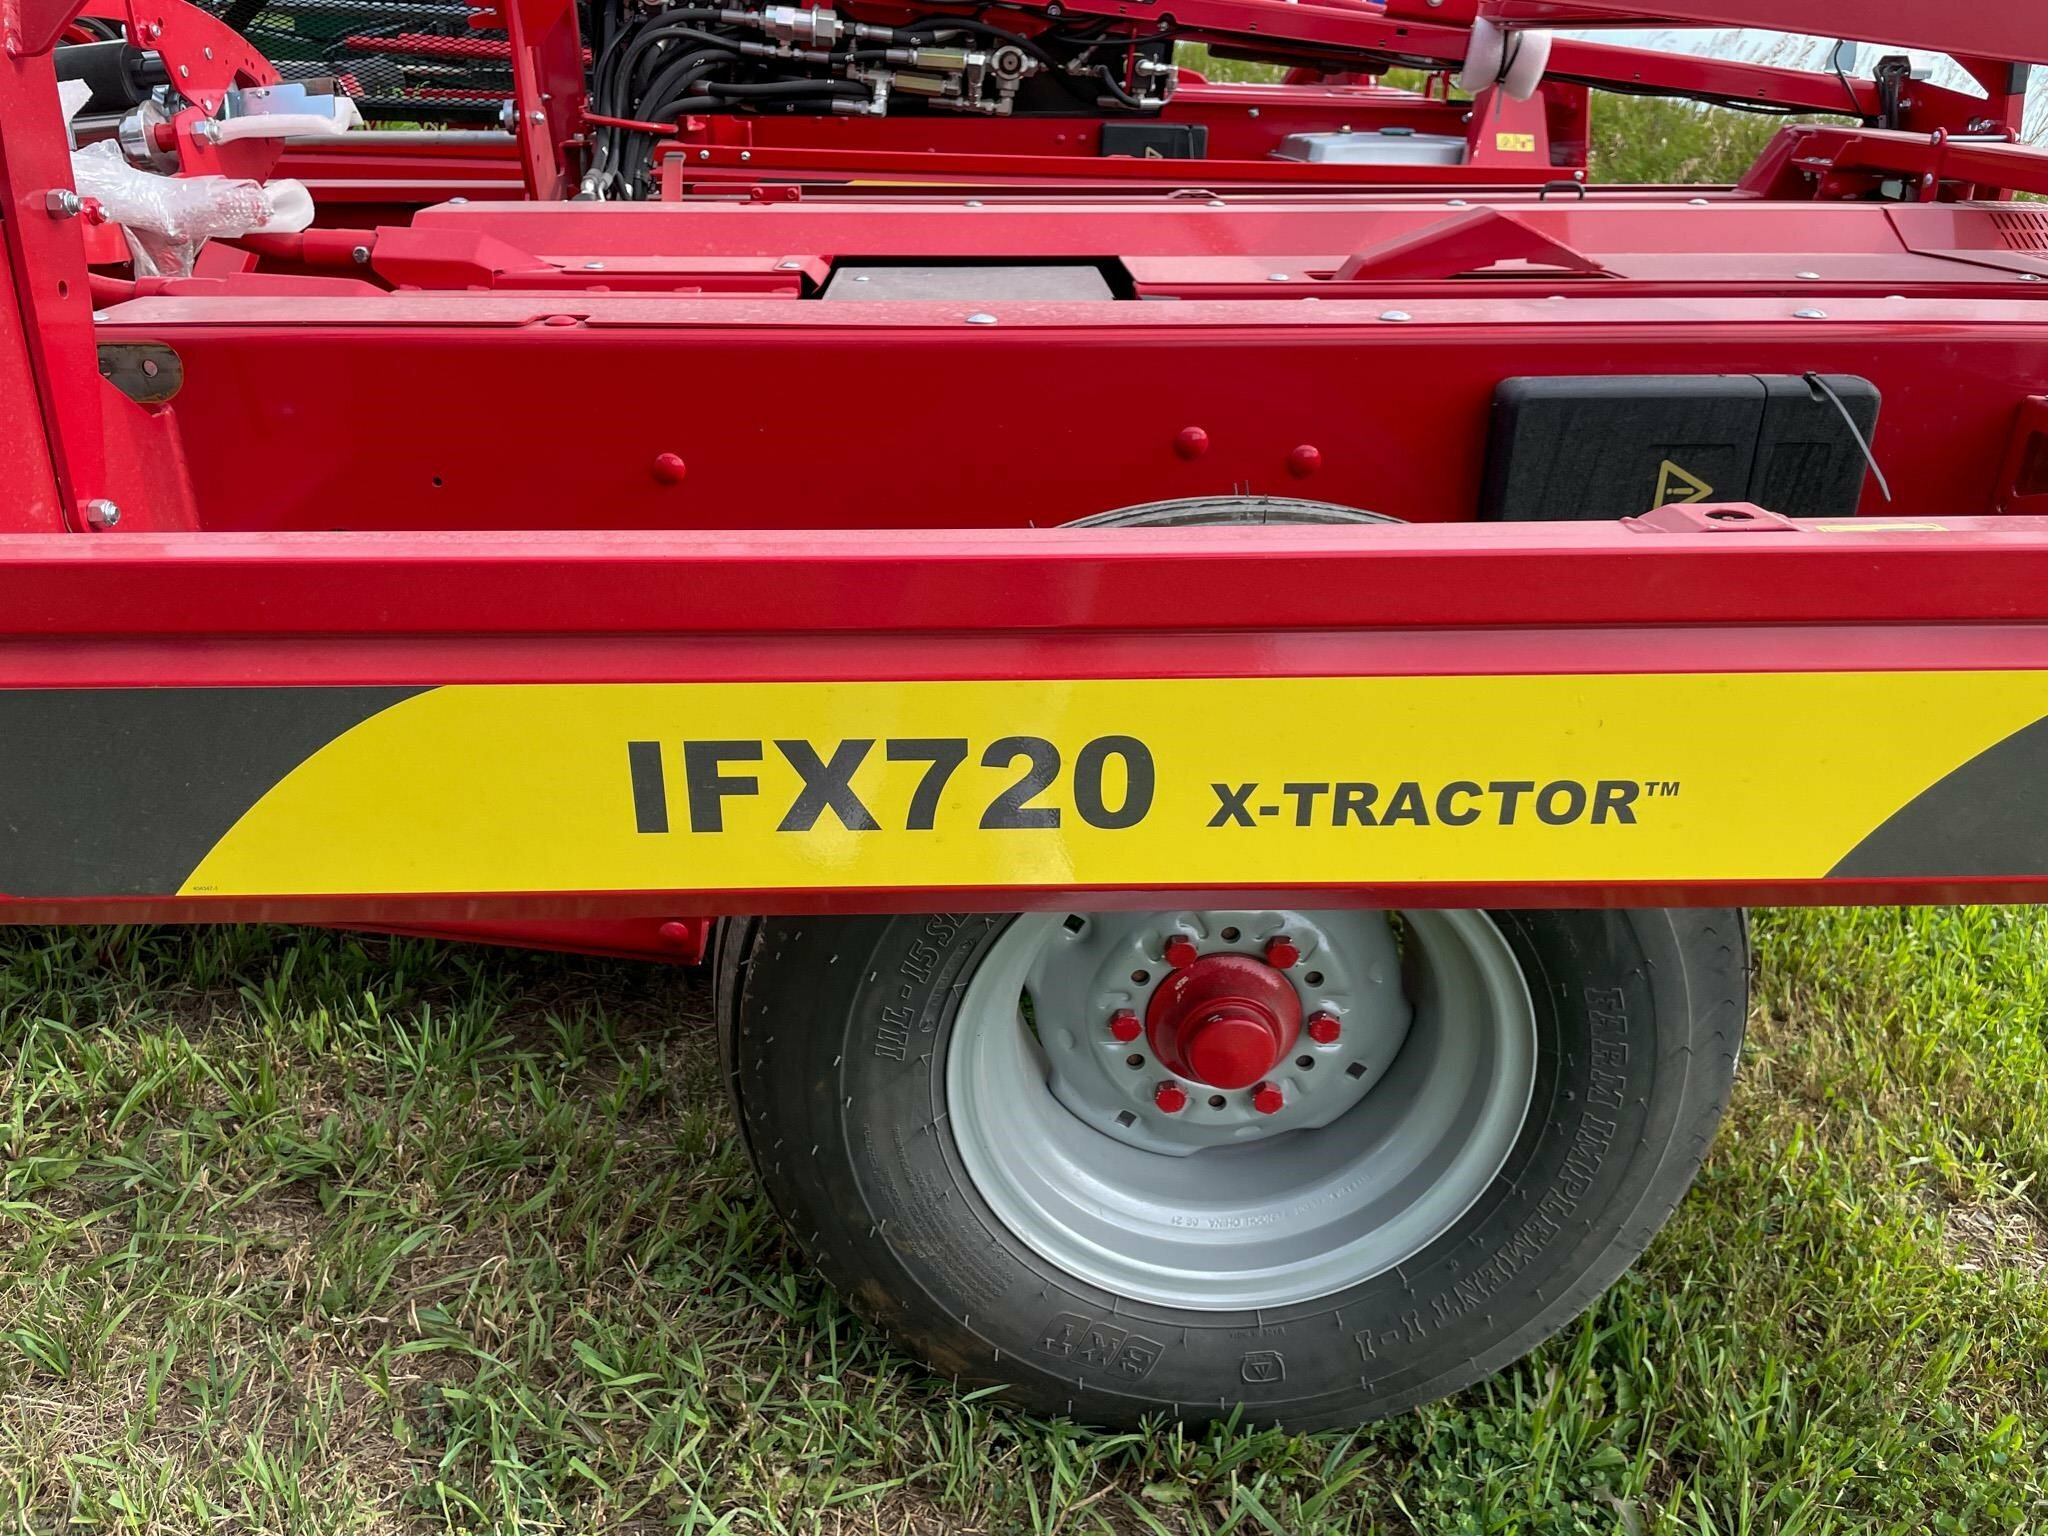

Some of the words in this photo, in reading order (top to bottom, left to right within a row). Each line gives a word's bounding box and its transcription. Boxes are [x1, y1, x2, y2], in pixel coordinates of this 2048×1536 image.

[627, 735, 1156, 834] IFX720
[1586, 987, 1628, 1109] FARM
[1430, 1111, 1617, 1329] IMPLEMENT
